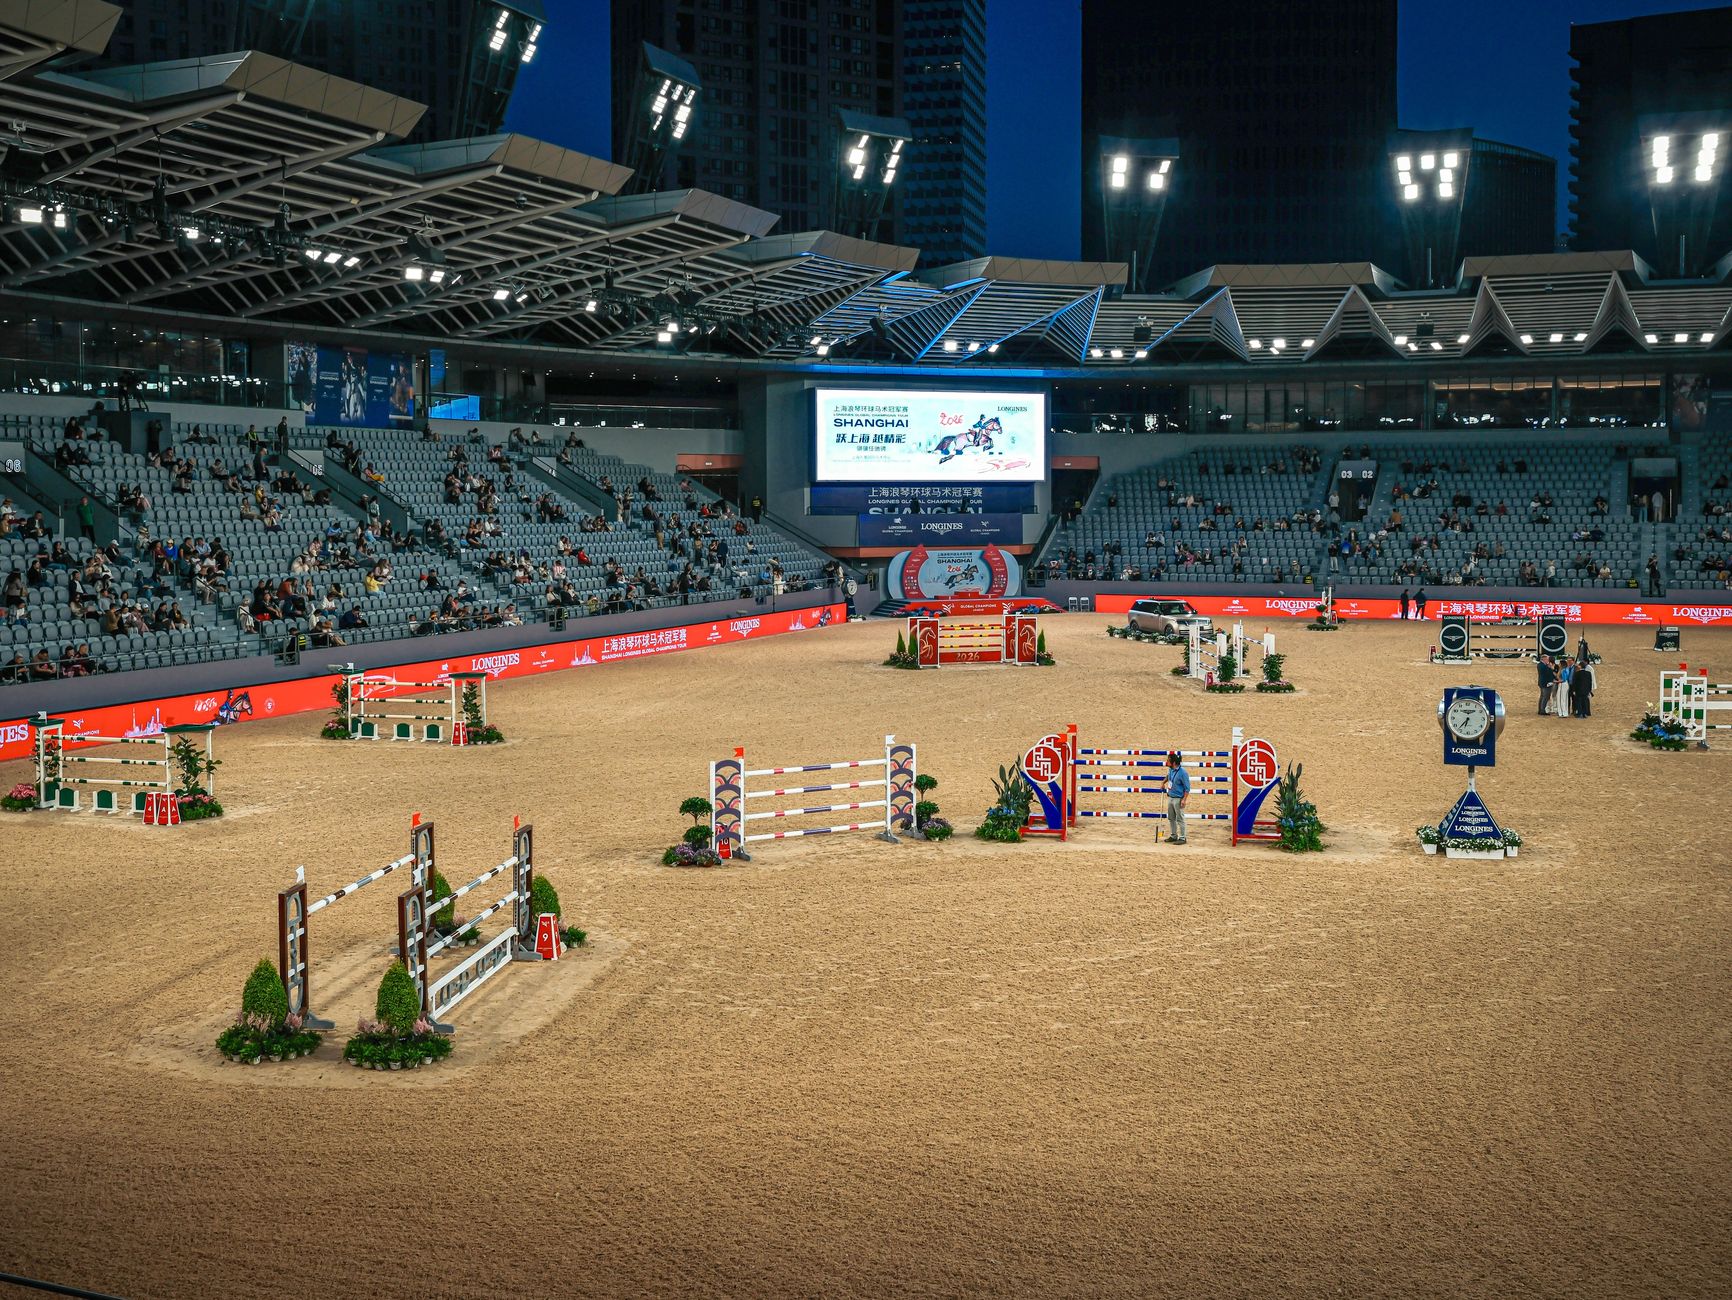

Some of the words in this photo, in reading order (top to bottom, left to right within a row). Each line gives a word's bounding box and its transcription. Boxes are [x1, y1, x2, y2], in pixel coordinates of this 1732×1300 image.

[998, 404, 1028, 412] LONGINES
[833, 418, 909, 428] SHANGHAI
[1341, 470, 1353, 479] 03
[1362, 470, 1374, 479] 02
[868, 487, 983, 498] 上海浪琴环球马术冠军赛
[921, 522, 964, 531] LONGINES
[1672, 607, 1732, 617] LONGINE
[730, 618, 760, 632] LONGINES
[601, 629, 687, 653] 上海浪琴环球马术冠军赛
[472, 653, 520, 671] LONGINES
[1451, 747, 1487, 755] LONGINES
[1454, 825, 1494, 833] LONGINES
[542, 932, 549, 942] 9
